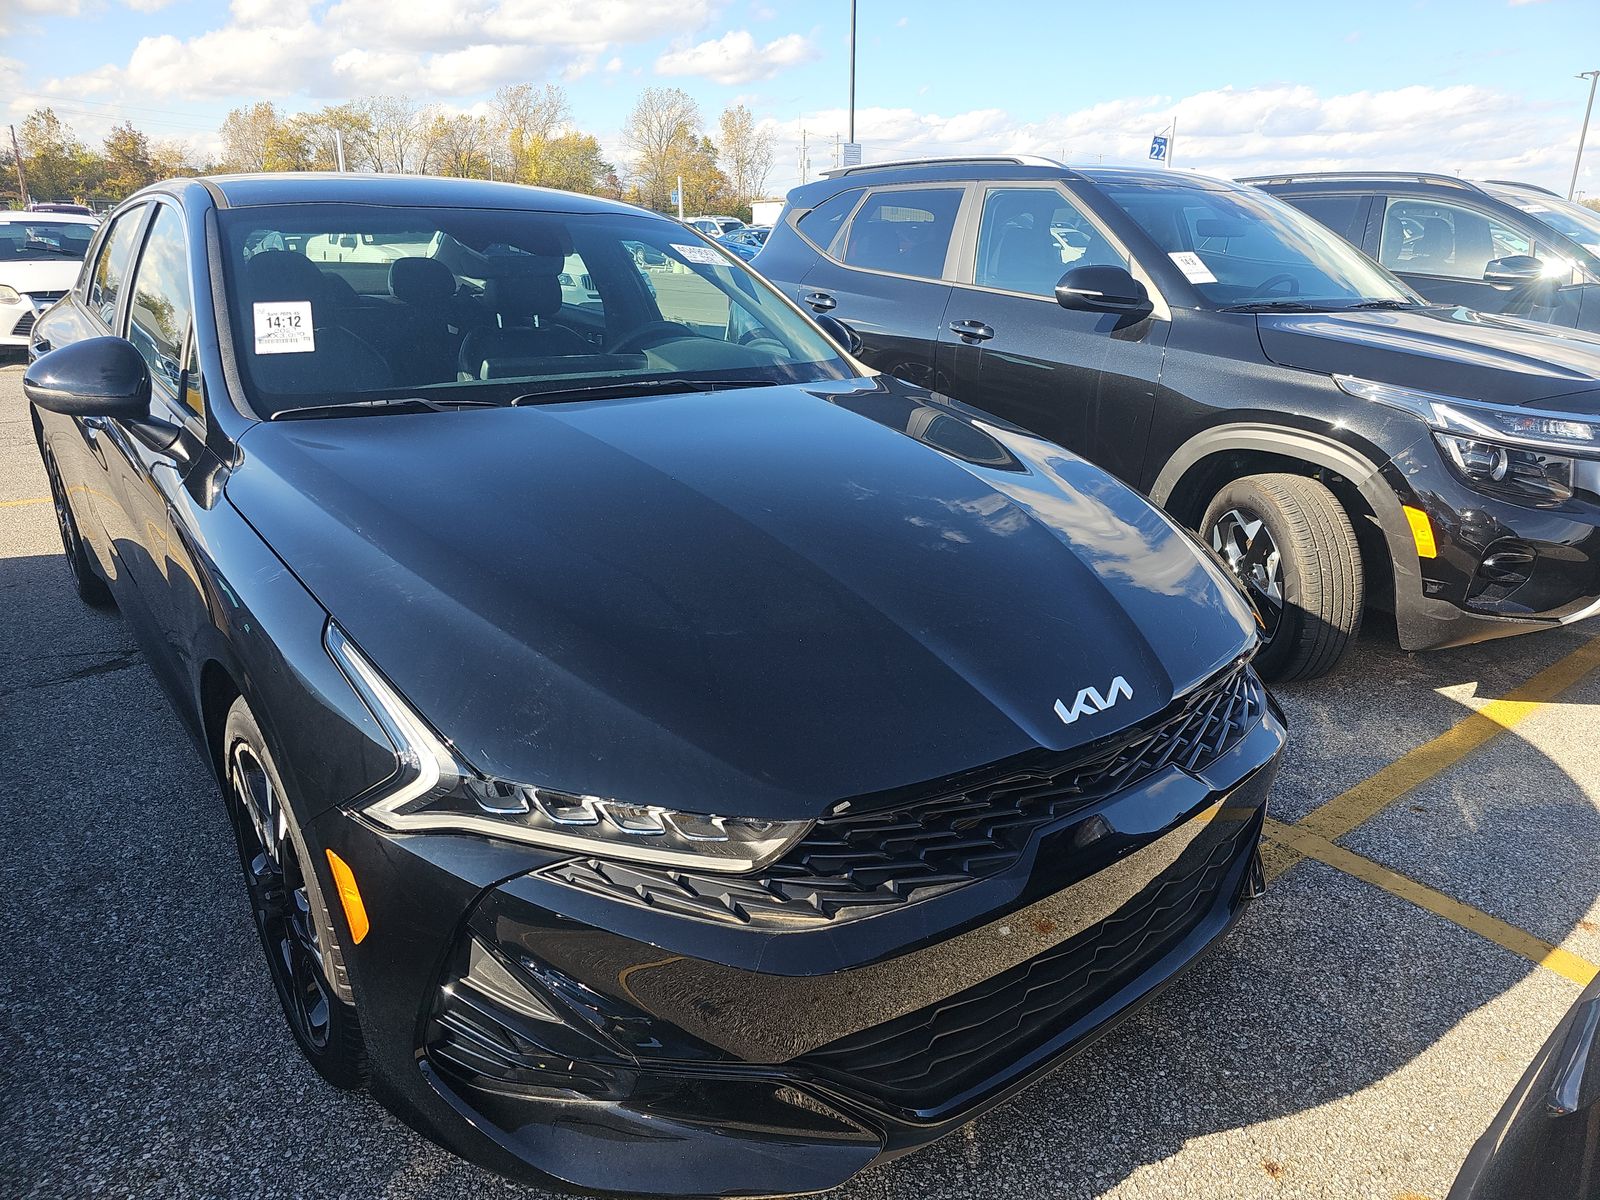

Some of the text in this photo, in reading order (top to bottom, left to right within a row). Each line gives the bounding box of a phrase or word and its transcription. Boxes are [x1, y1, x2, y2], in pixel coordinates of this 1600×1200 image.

[1150, 143, 1166, 160] 22
[266, 315, 302, 329] 14:12
[1053, 675, 1134, 724] KIA
